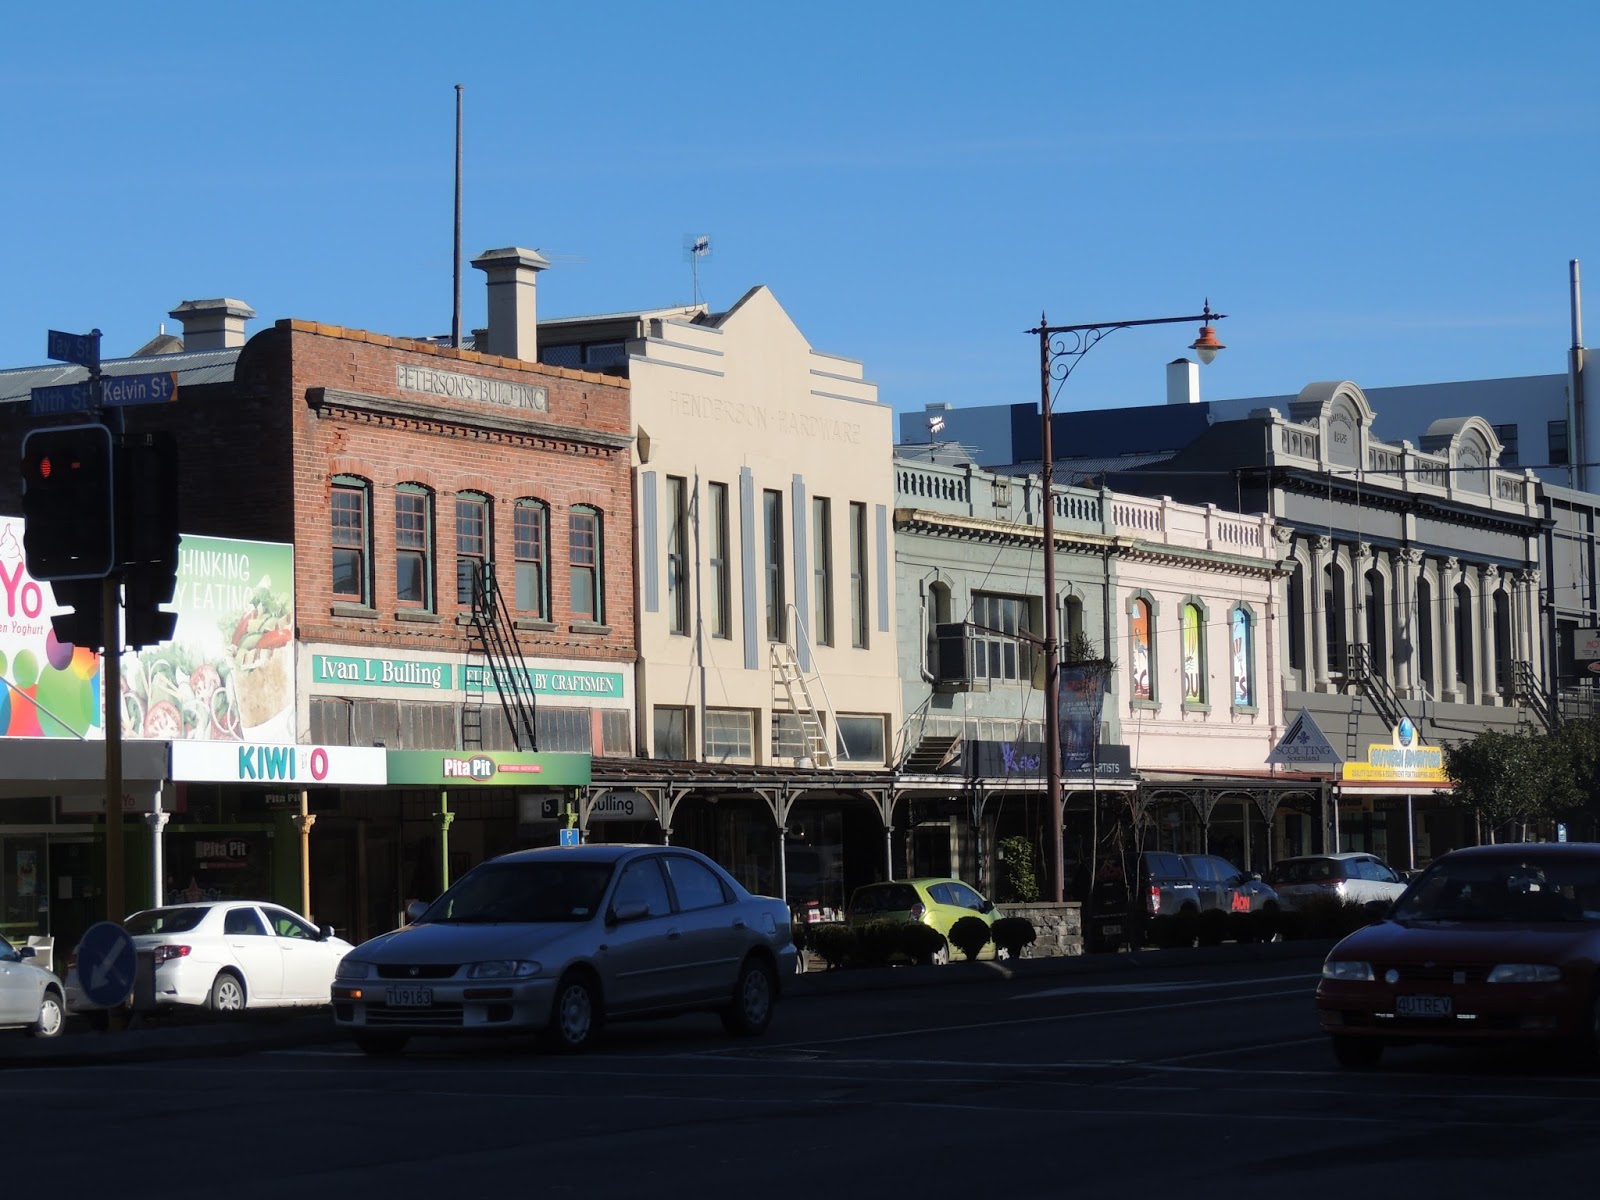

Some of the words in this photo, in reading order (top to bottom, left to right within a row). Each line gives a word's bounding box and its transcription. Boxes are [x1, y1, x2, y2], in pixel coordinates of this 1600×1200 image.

[50, 332, 71, 358] Tay
[76, 337, 91, 359] St
[33, 388, 64, 412] Nith
[71, 386, 88, 410] St
[103, 379, 146, 402] Kelvin
[150, 376, 167, 398] St
[668, 390, 767, 432] HENDERSON
[777, 410, 861, 444] HARDWARE
[179, 549, 250, 581] HINKING
[11, 620, 44, 636] Yoghurt
[320, 656, 360, 681] Ivan
[364, 659, 377, 682] L
[381, 660, 442, 688] Bulling
[534, 673, 549, 690] BY
[551, 674, 615, 693] CRAFTSMEN
[1275, 745, 1330, 754] SCOUTING
[239, 745, 296, 781] KIWI
[444, 758, 471, 777] Pita
[472, 759, 491, 777] Pit
[265, 793, 285, 804] Pita
[203, 841, 227, 857] Pita
[229, 841, 247, 857] Pit
[387, 990, 430, 1005] TU9183
